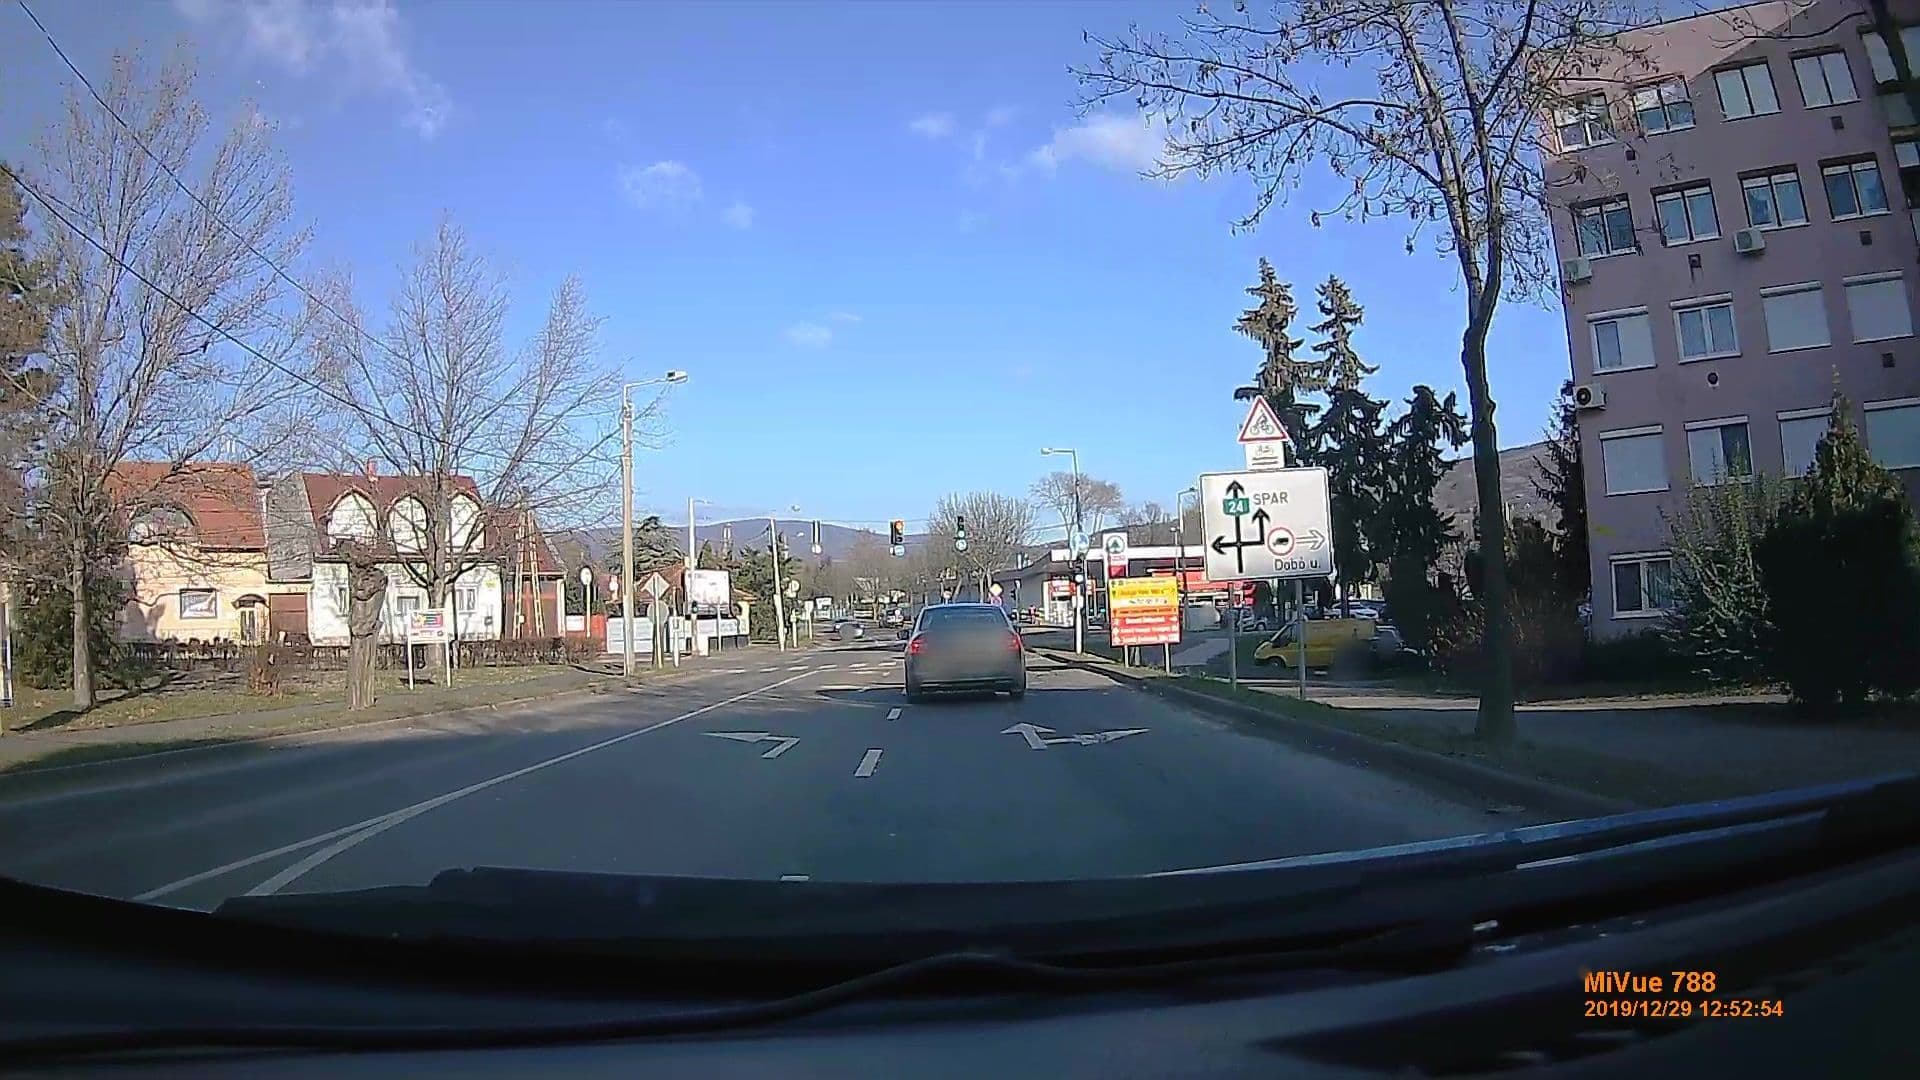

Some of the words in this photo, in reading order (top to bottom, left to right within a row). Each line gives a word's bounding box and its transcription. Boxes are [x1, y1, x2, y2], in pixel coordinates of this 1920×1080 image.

[1253, 491, 1288, 505] SPAR
[1228, 500, 1244, 513] 24
[1274, 557, 1306, 571] Dobó
[1310, 560, 1321, 569] u.
